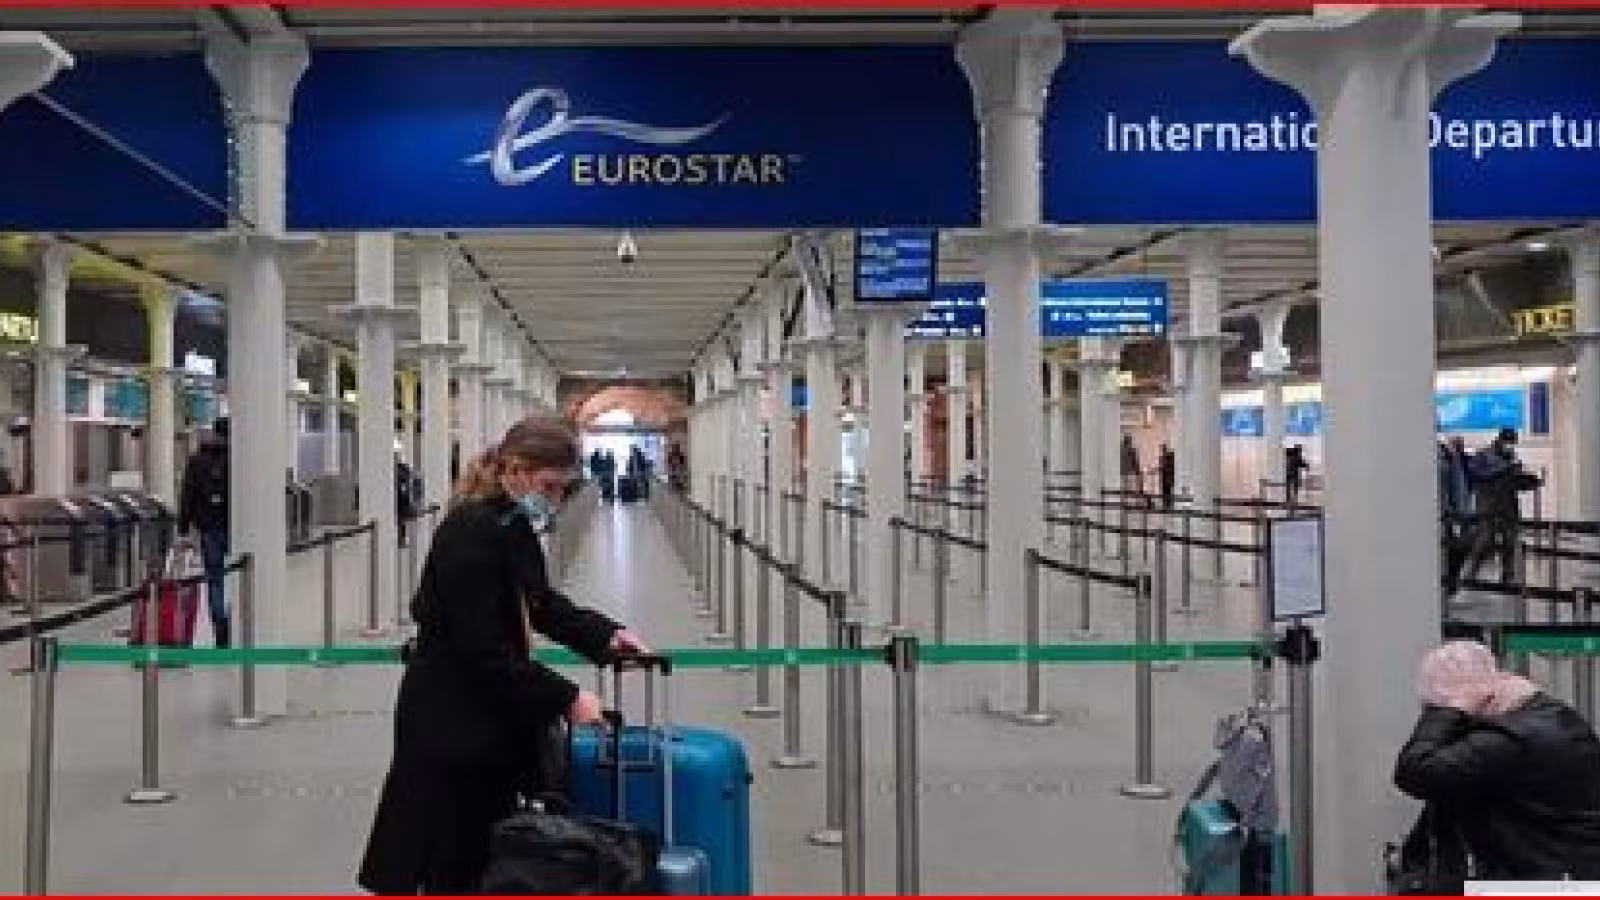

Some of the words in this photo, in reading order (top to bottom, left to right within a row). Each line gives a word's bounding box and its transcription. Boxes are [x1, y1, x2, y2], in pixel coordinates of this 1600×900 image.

[1106, 112, 1320, 151] Internatio
[1428, 112, 1600, 158] epartu
[573, 154, 785, 185] EUROSTAR
